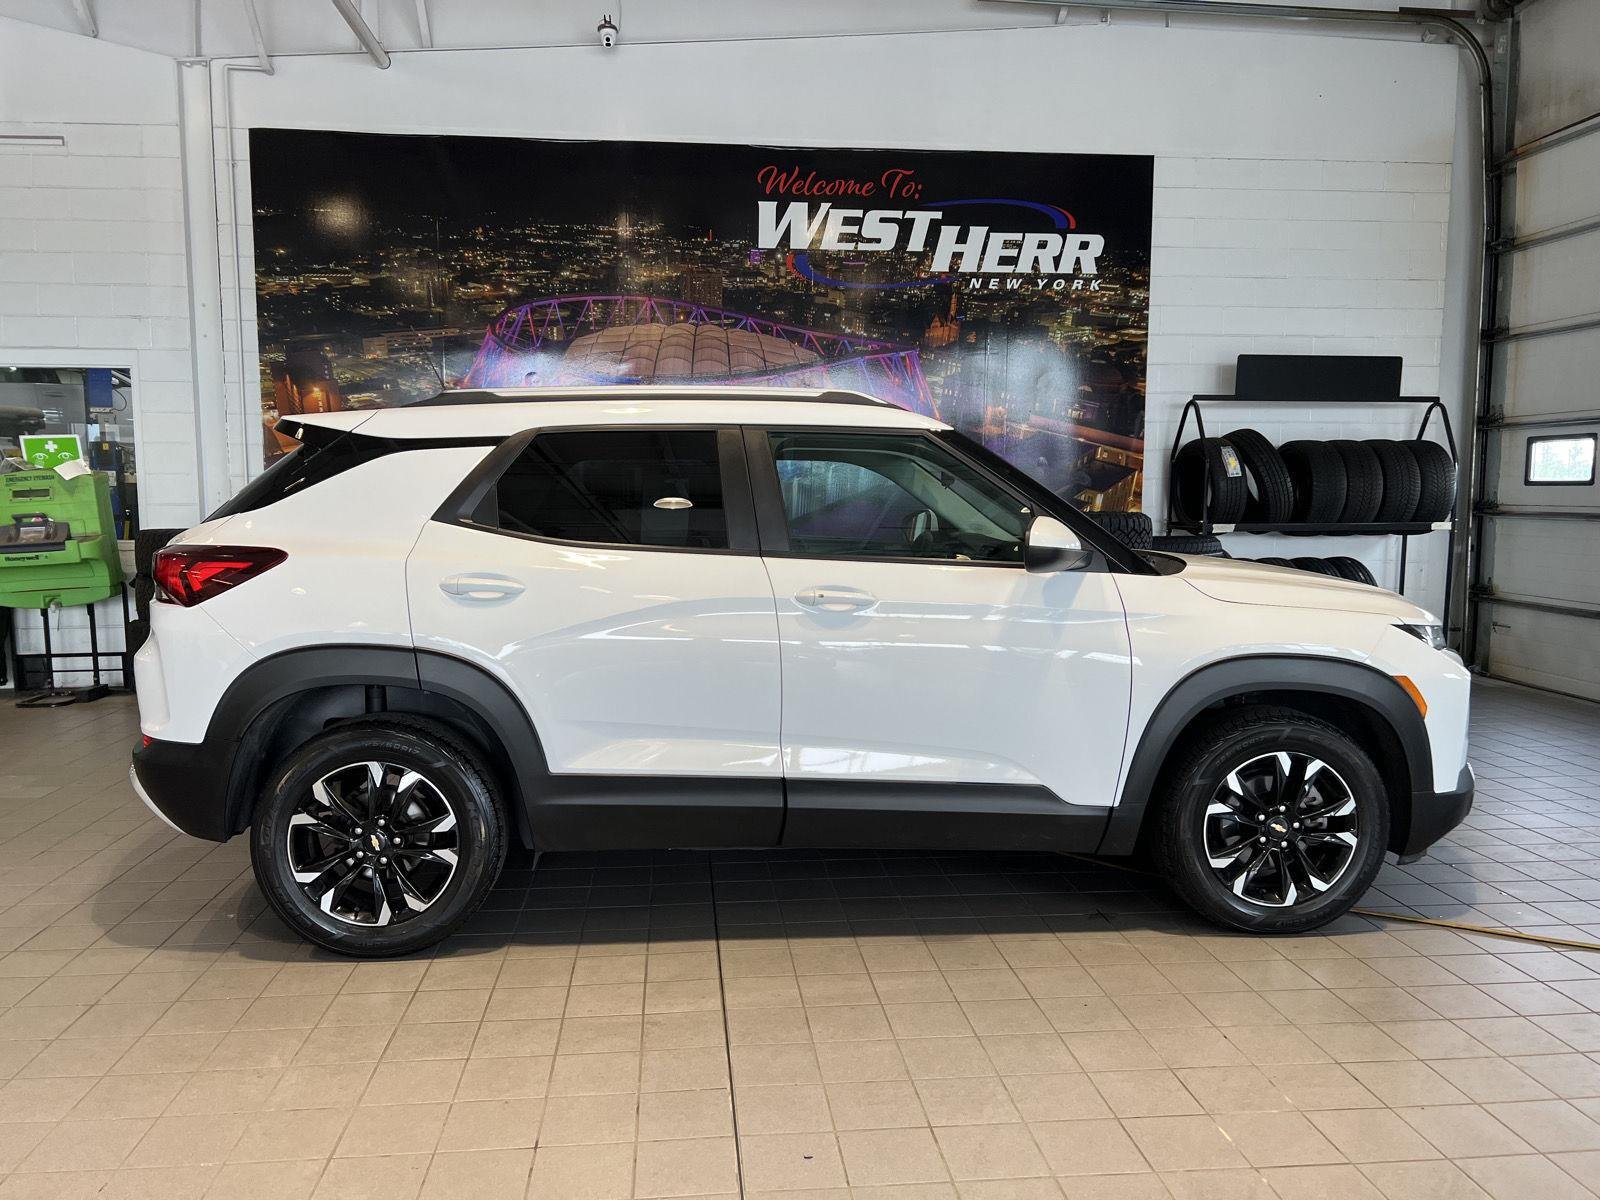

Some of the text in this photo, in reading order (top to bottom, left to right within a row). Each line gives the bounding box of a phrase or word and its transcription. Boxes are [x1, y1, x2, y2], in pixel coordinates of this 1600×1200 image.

[757, 165, 922, 199] Welcome To:
[757, 200, 1105, 274] WEST HERR
[969, 278, 1101, 291] NEW YORK
[4, 554, 39, 562] Honeywell
